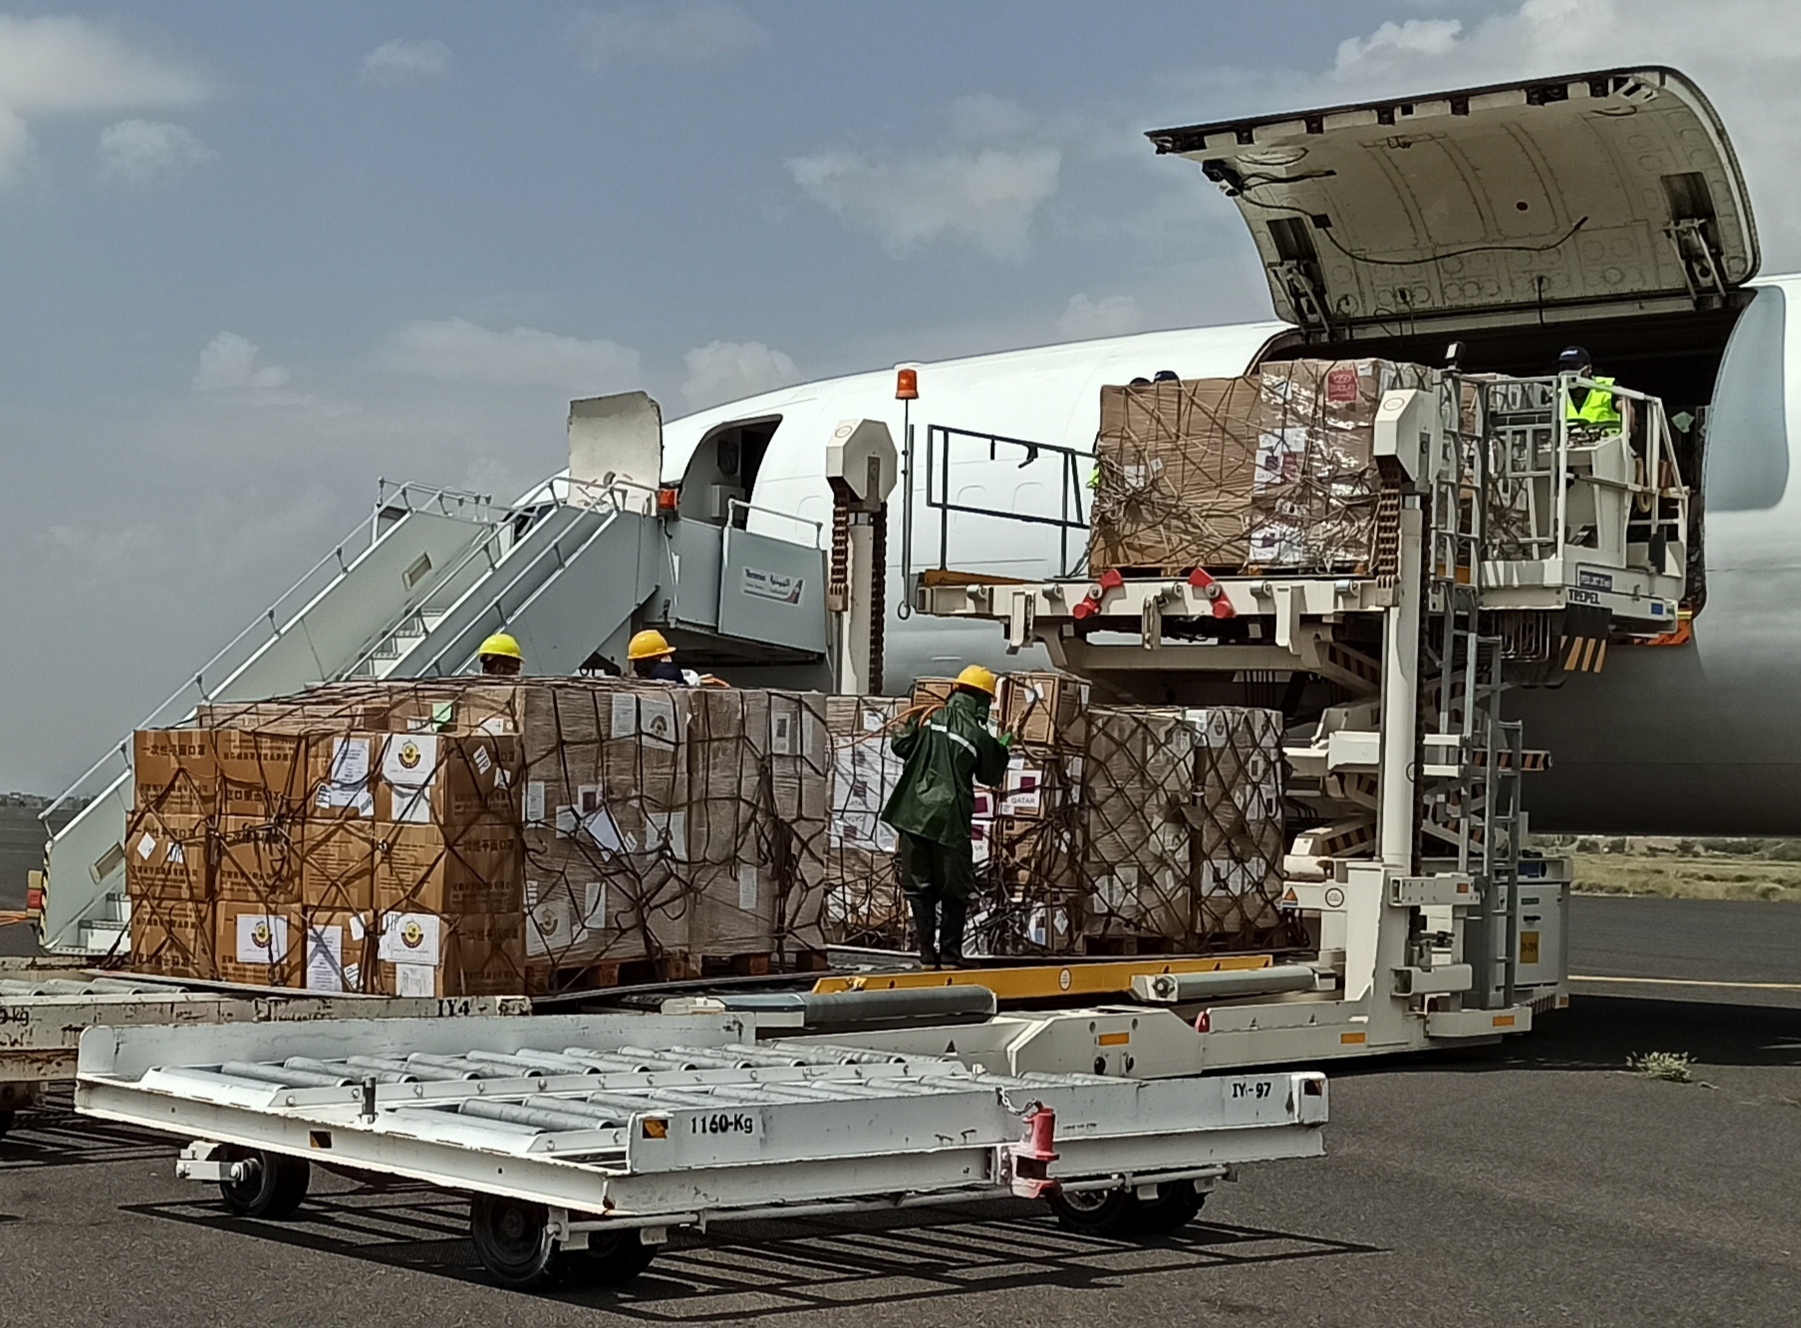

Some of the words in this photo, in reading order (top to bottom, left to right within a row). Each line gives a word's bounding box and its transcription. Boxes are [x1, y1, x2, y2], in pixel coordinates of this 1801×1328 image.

[475, 748, 490, 768] VIP
[1011, 796, 1035, 805] QATAR
[1232, 1082, 1271, 1099] IY-97
[691, 1113, 753, 1134] 1160-Kg
